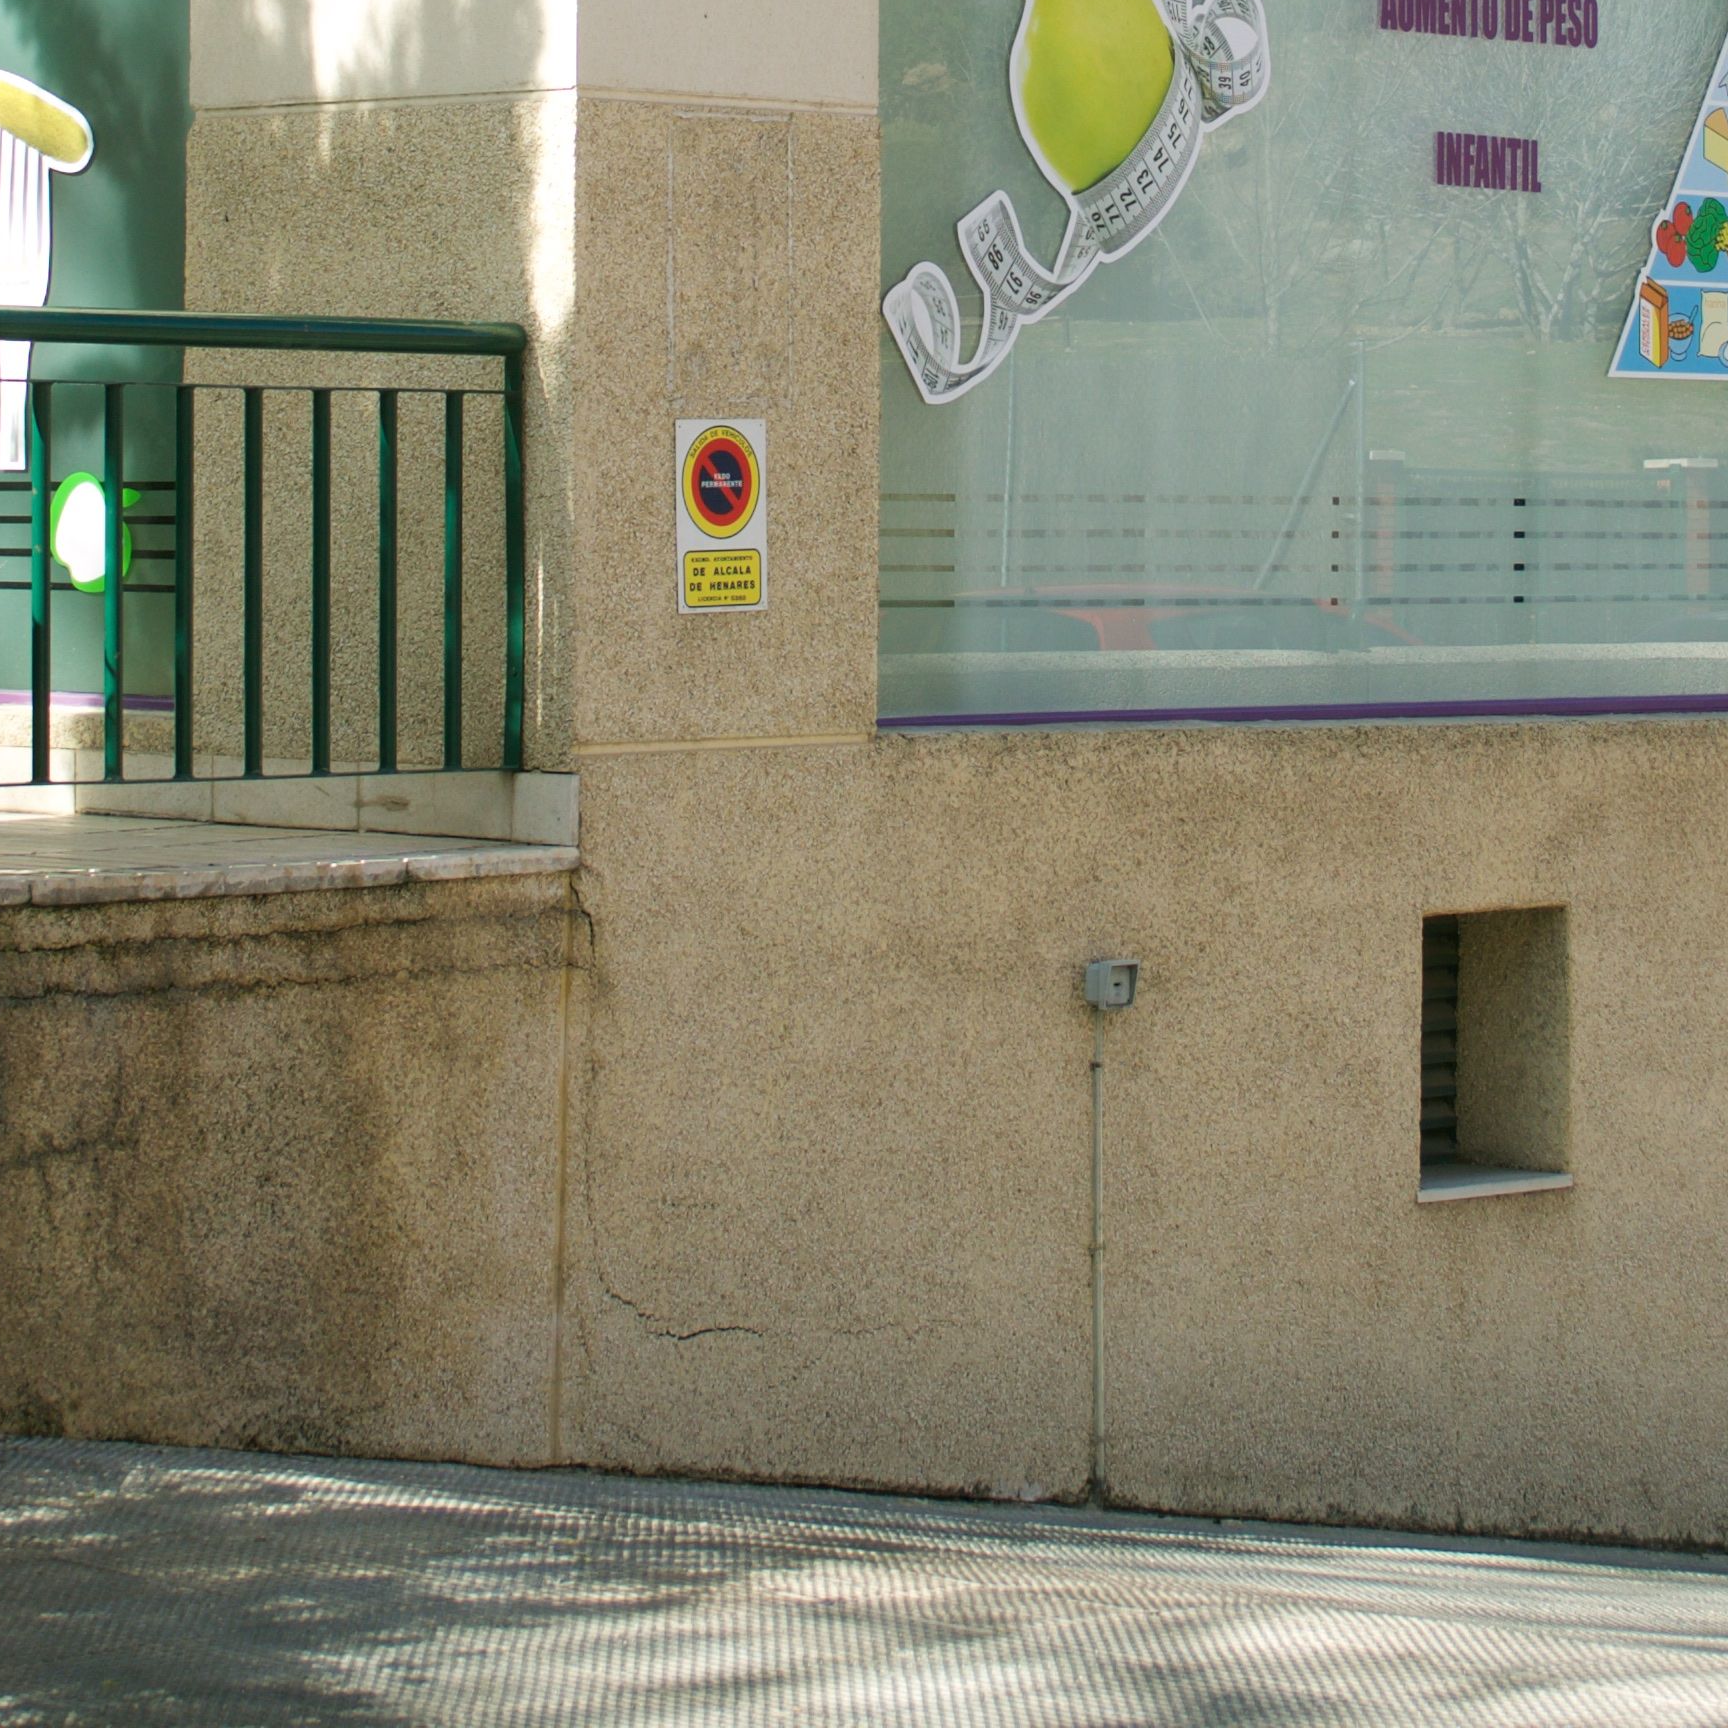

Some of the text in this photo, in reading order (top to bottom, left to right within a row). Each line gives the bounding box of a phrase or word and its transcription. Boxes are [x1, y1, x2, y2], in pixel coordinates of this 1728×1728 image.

[1218, 76, 1232, 90] 39
[1239, 70, 1251, 87] 40
[1177, 98, 1190, 124] 76
[1167, 122, 1182, 149] 75
[1153, 146, 1169, 173] 74
[1434, 130, 1543, 193] INFANTIL
[1136, 168, 1154, 195] 73
[1119, 187, 1137, 212] 72
[1091, 211, 1105, 233] 70
[1104, 203, 1120, 225] 71
[987, 243, 1004, 271] 98
[1005, 271, 1024, 295] 97
[1025, 290, 1042, 306] 96
[693, 565, 751, 576] DE ALCALA
[689, 579, 755, 592] DE HENARES
